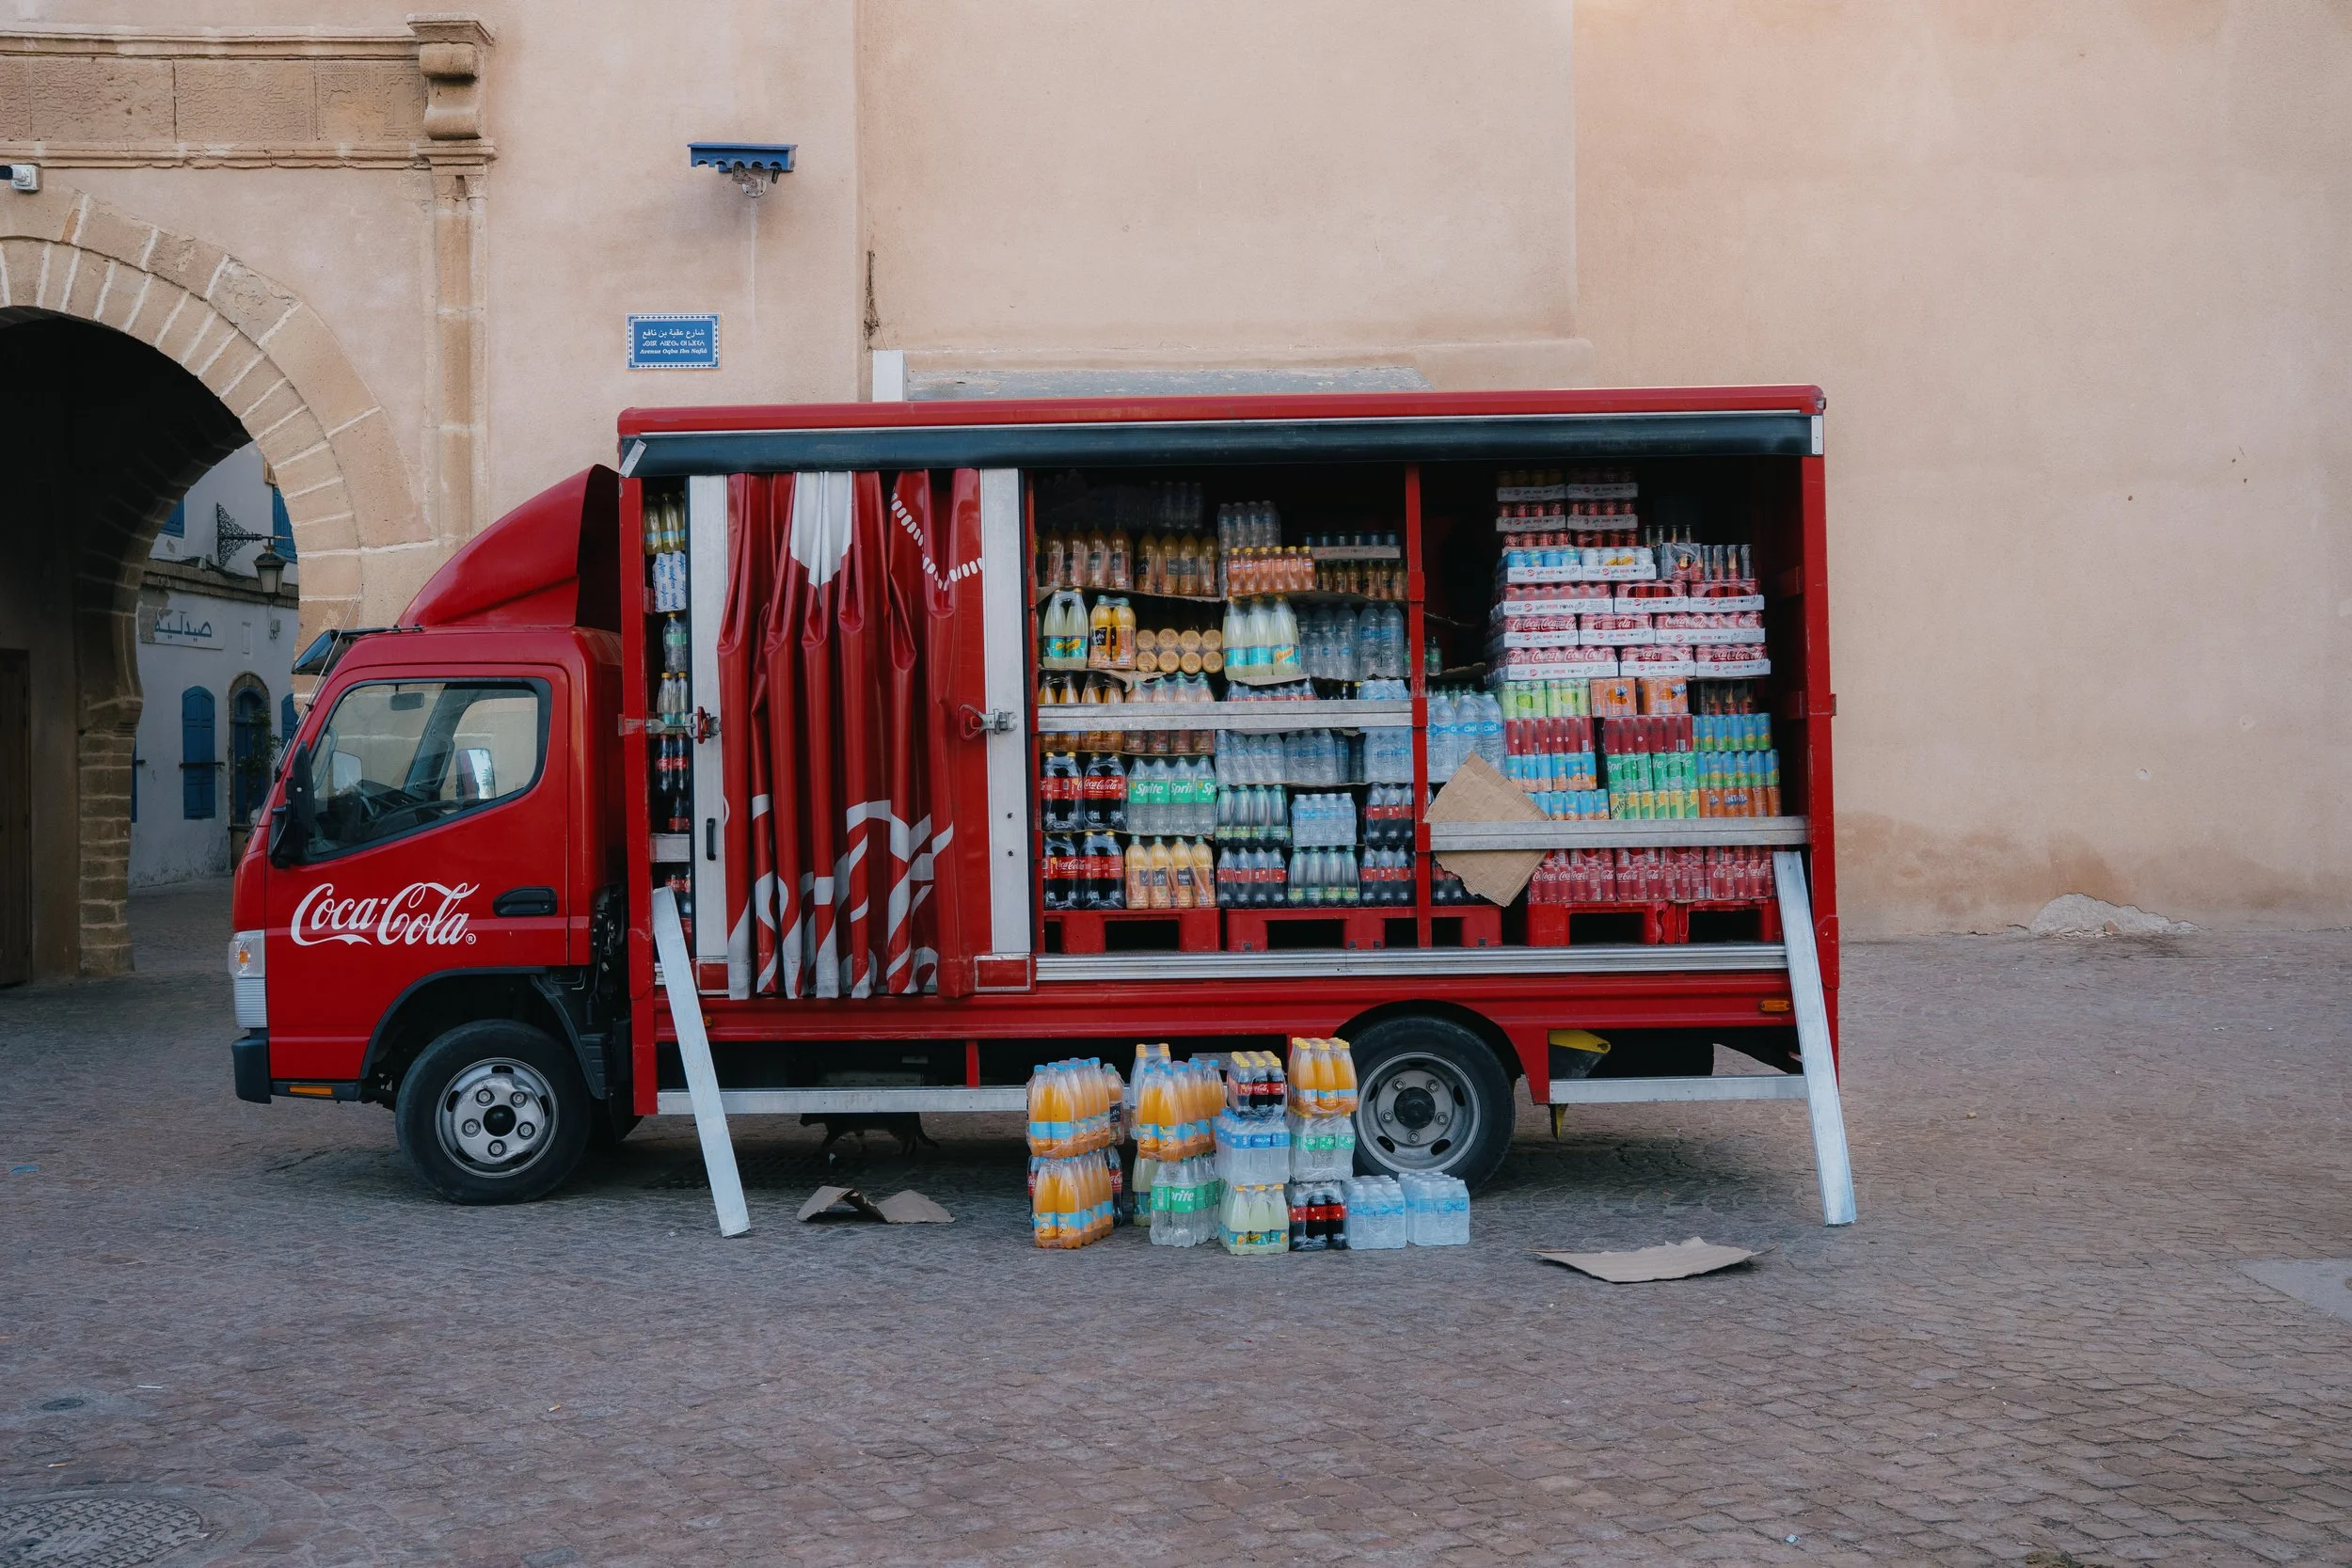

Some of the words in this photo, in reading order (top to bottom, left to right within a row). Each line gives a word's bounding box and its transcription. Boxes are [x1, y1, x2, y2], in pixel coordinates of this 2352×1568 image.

[642, 329, 657, 339] نافع
[659, 330, 668, 339] بن
[669, 329, 684, 339] عقبة
[686, 329, 705, 339] شارع
[1464, 723, 1477, 732] ciel
[1484, 723, 1497, 732] ciel
[1136, 782, 1164, 796] Sprite
